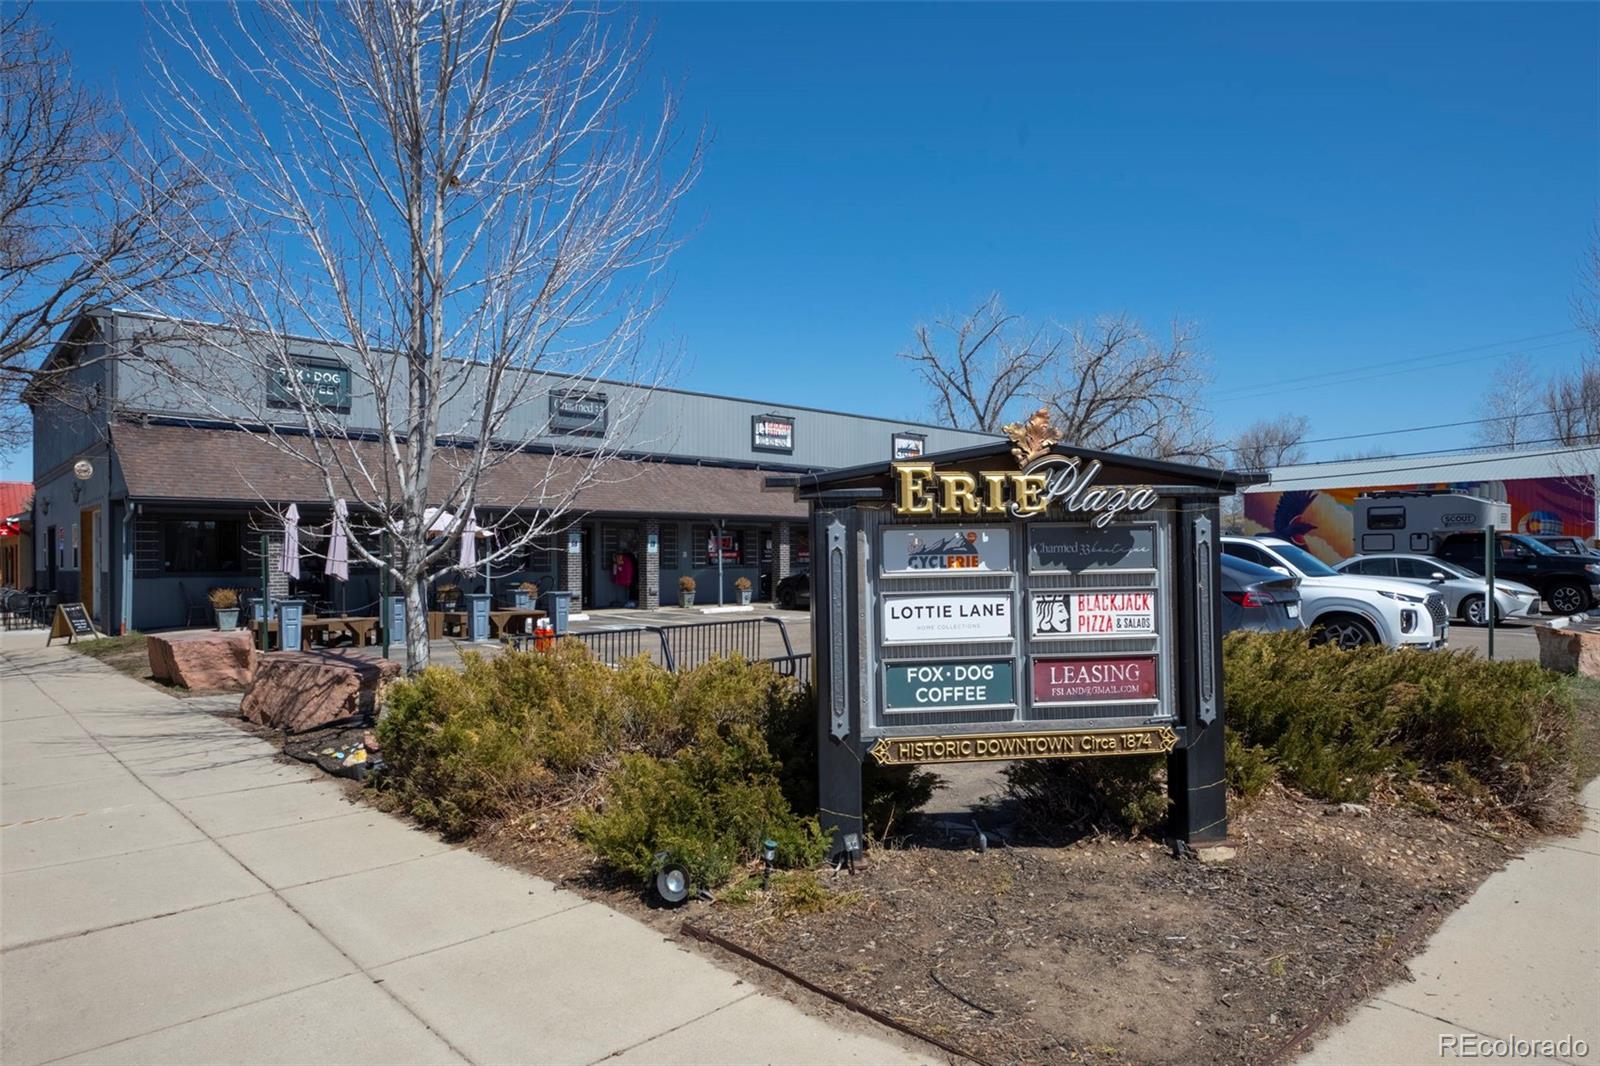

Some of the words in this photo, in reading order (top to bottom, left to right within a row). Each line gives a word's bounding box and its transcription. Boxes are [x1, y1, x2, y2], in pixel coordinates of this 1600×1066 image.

[279, 367, 304, 381] FX
[314, 371, 341, 384] DOG
[286, 381, 334, 395] CFFEE
[893, 462, 1047, 516] ERIE
[1011, 455, 1159, 528] Plaza
[1035, 541, 1078, 554] Charmed
[908, 555, 979, 569] CYCLERIE
[1078, 592, 1150, 611] BLACKJACK
[891, 605, 952, 619] LOTTIE
[959, 603, 1005, 618] LANE
[937, 623, 980, 631] COLLECTIONS
[1078, 614, 1113, 632] PIZZA
[1116, 617, 1121, 628] &
[1124, 617, 1151, 629] SALADS
[1050, 663, 1140, 685] LEASING
[915, 686, 987, 703] COFFEE
[899, 740, 971, 758] HISTORIC
[976, 736, 1075, 754] DOWNTOWN
[1081, 736, 1117, 750] Circa
[1121, 733, 1152, 748] 1874
